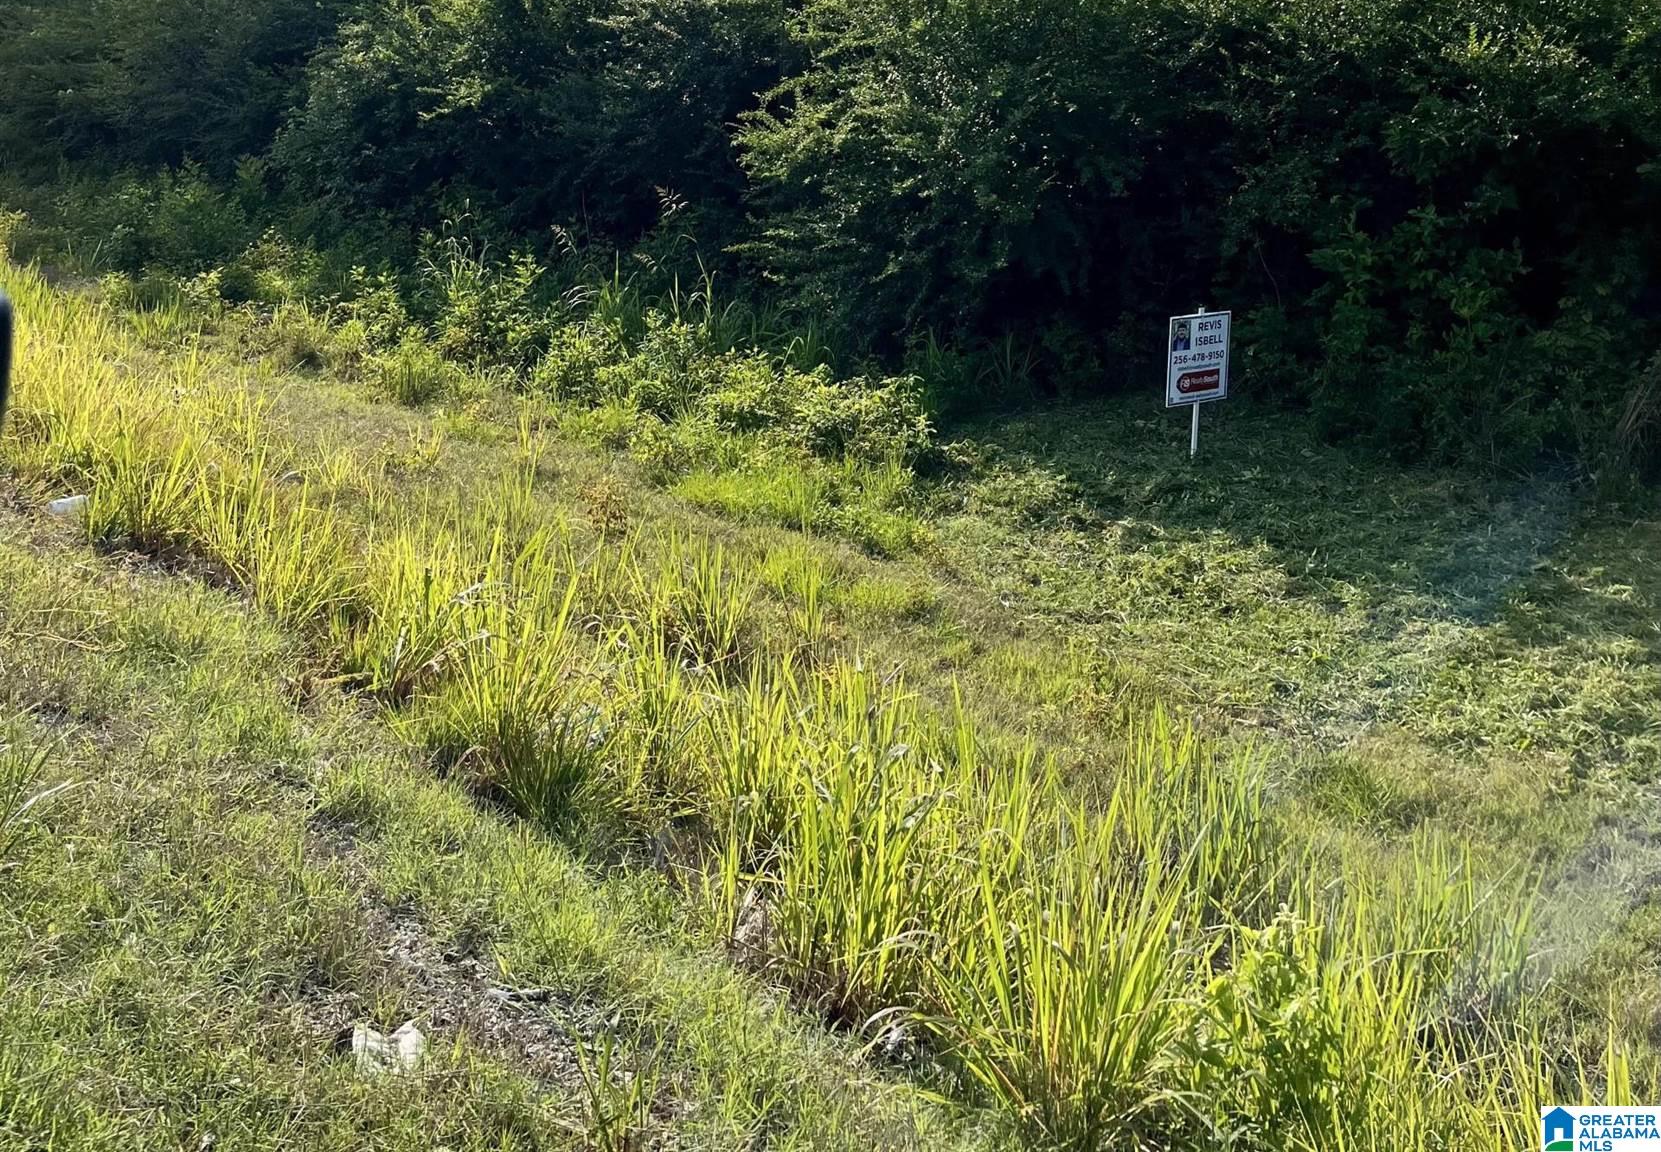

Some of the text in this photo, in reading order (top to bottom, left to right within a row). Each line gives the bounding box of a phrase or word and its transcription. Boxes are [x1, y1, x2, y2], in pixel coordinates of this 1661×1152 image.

[1198, 320, 1222, 332] REVIS
[1195, 335, 1223, 347] ISBELL
[1173, 350, 1225, 365] 256-478-9150
